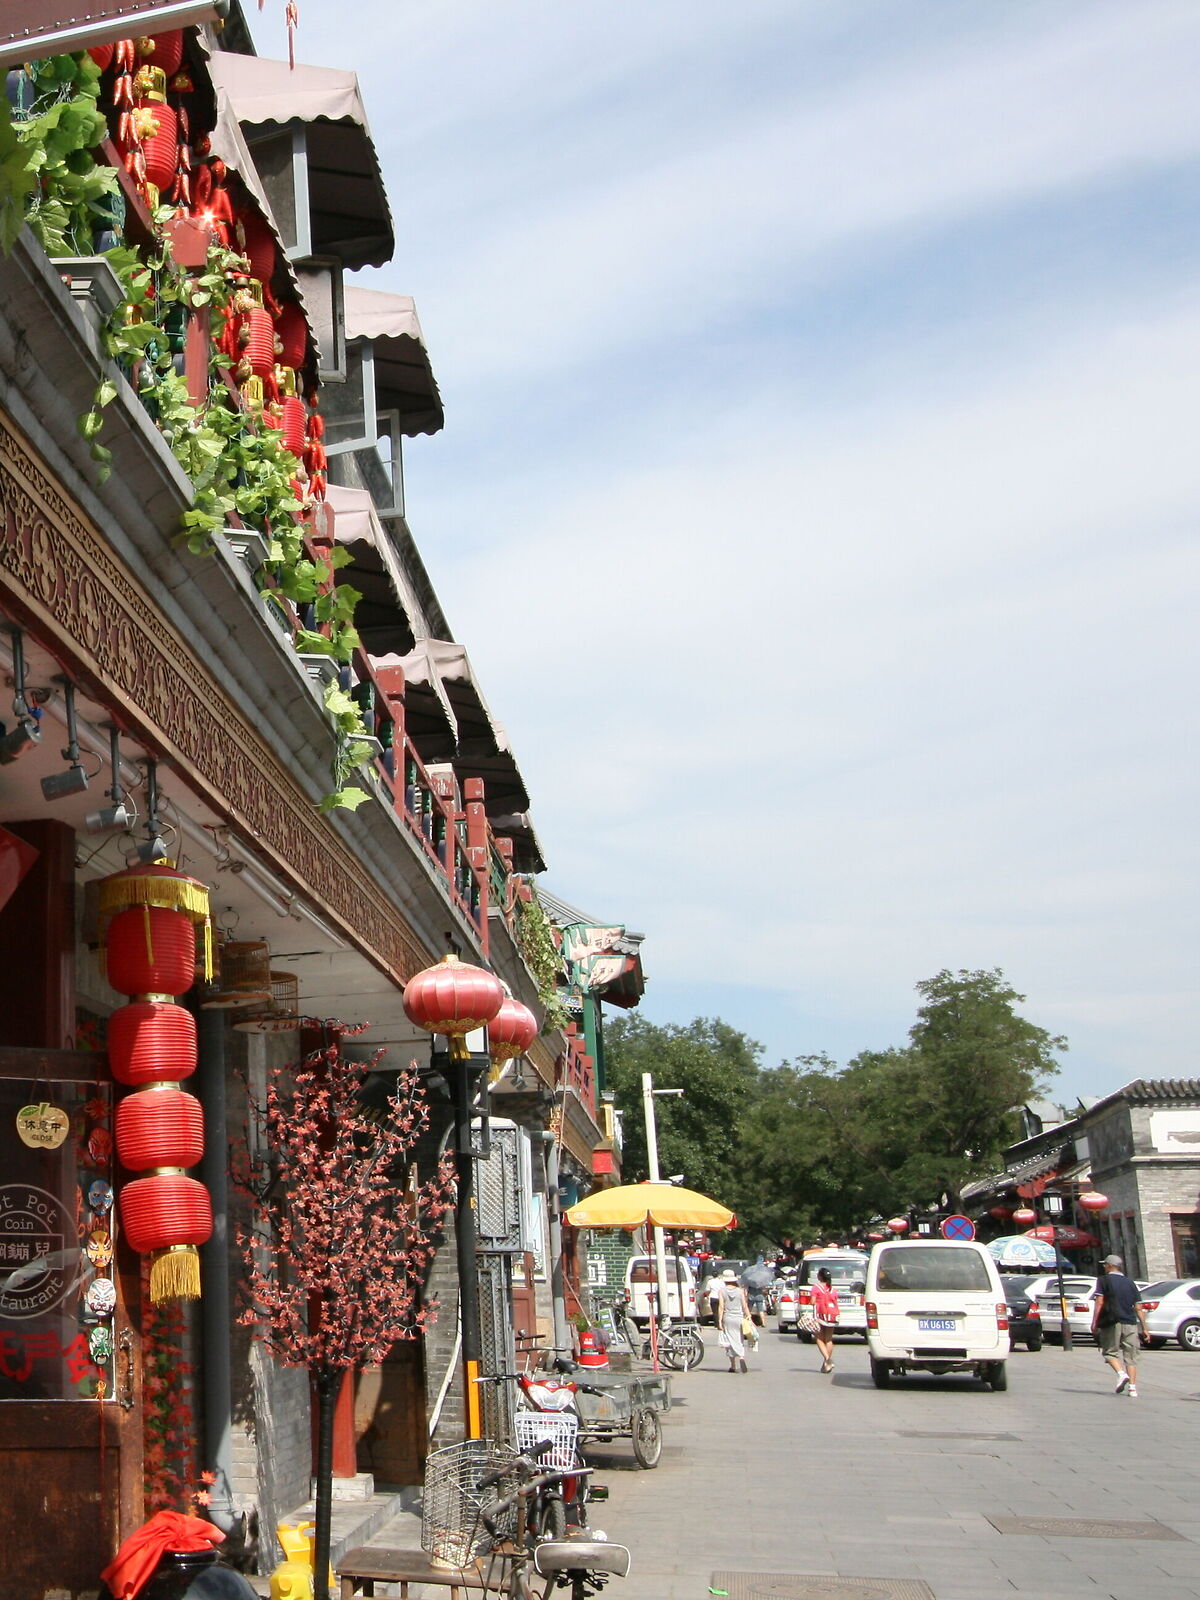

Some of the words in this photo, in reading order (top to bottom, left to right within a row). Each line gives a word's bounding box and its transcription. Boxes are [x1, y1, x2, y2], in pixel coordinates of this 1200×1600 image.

[24, 1120, 62, 1133] 休息中
[31, 1134, 54, 1142] CLOSE
[4, 1218, 34, 1230] Coin
